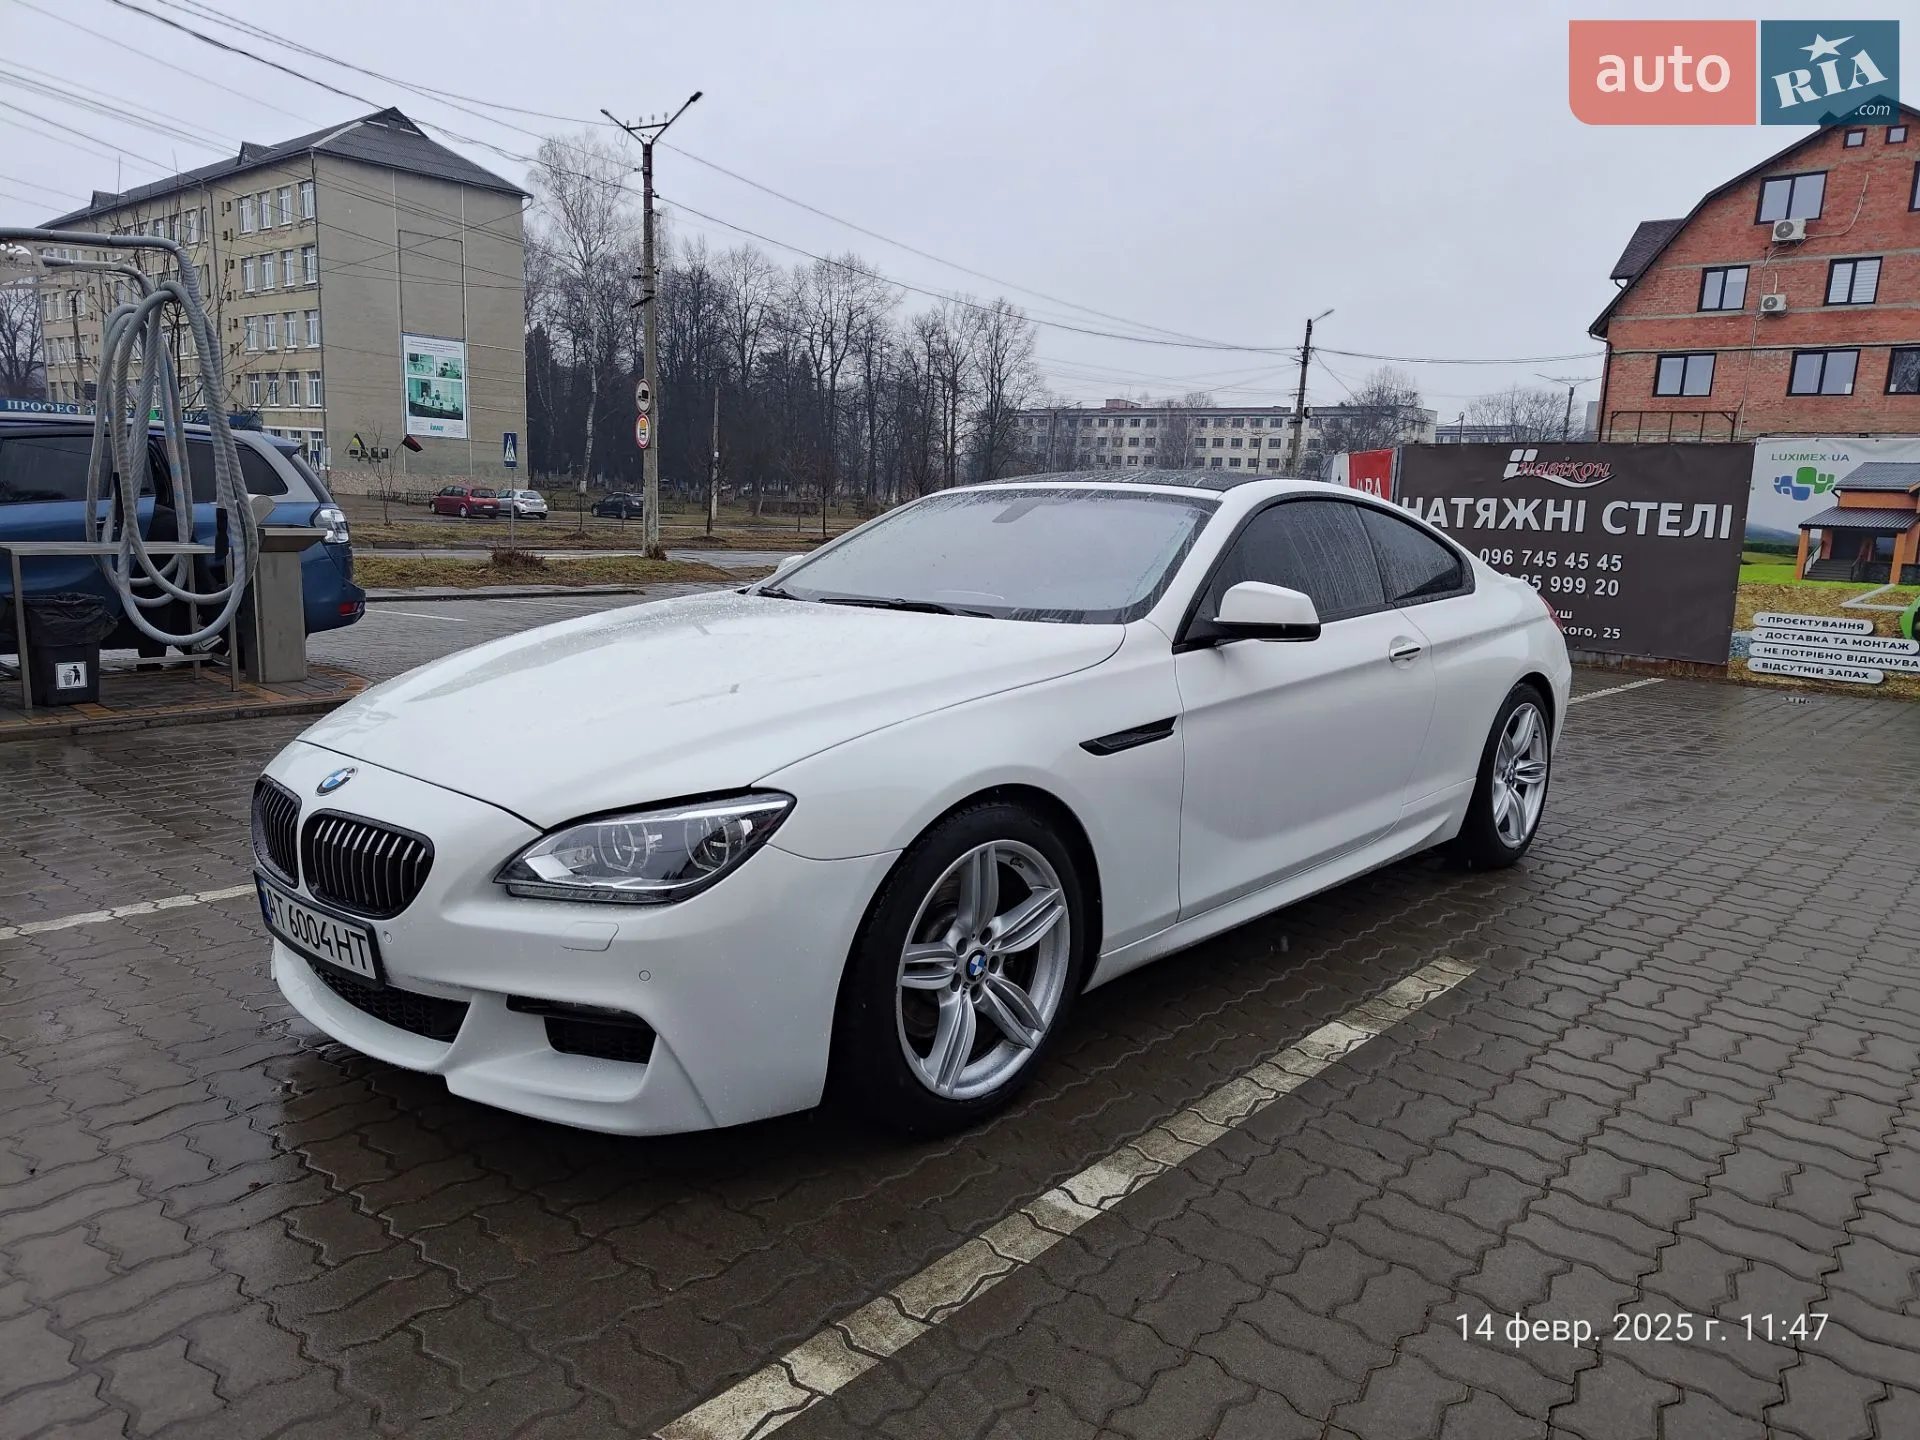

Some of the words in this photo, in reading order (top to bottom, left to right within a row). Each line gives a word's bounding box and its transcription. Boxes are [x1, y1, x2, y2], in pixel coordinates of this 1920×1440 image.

[1402, 496, 1587, 533] НАТЯЖНІ
[1601, 500, 1733, 539] СТЕЛІ
[1479, 548, 1514, 566] 096
[1521, 550, 1557, 568] 745
[1564, 552, 1589, 570] 45
[1597, 554, 1622, 572] 45
[1550, 576, 1586, 594] 999
[1594, 579, 1619, 597] 20
[1768, 616, 1865, 631] ПРОЄКТУВАННЯ
[1603, 628, 1621, 639] 25
[1765, 631, 1830, 645] ДОСТАВКА
[1833, 637, 1849, 646] ТА
[1851, 640, 1911, 651] МОНТАЖ
[1764, 647, 1779, 655] НЕ
[1782, 649, 1843, 661] ПОТРІБНО
[1762, 662, 1825, 676] ВІДСУТНІЙ
[1827, 669, 1870, 680] ЗАПАХ
